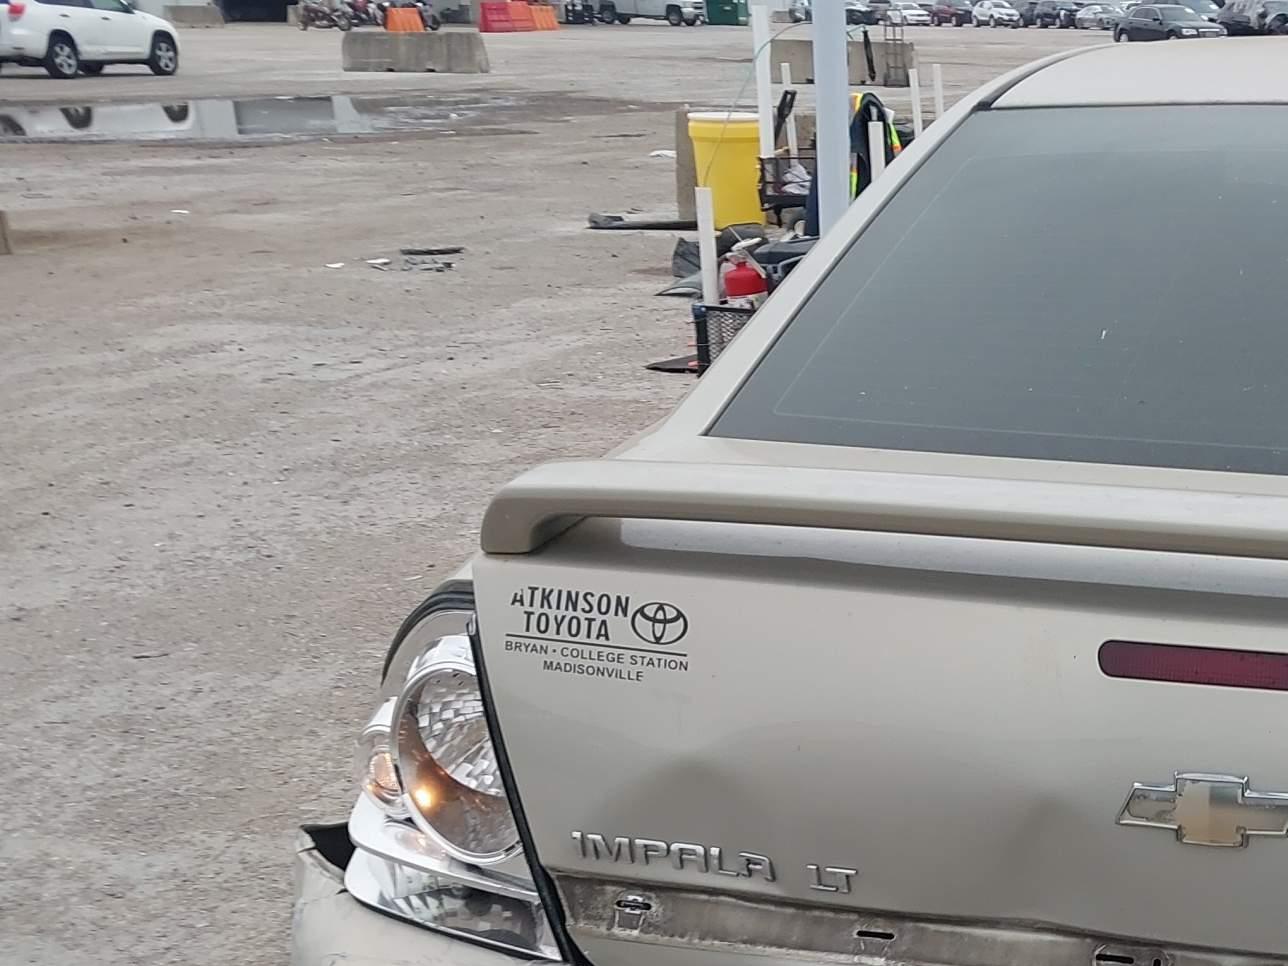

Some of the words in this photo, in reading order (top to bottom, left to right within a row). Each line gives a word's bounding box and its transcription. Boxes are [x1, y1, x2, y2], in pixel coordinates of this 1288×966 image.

[510, 586, 630, 618] ATKINSON
[523, 610, 611, 642] TOYOTA
[504, 640, 549, 656] BRYAN
[560, 646, 625, 665] COLLEGE
[629, 654, 689, 672] STATION
[542, 660, 644, 682] MADISONVILLE
[571, 830, 777, 884] IMPALA
[806, 863, 858, 894] LT
